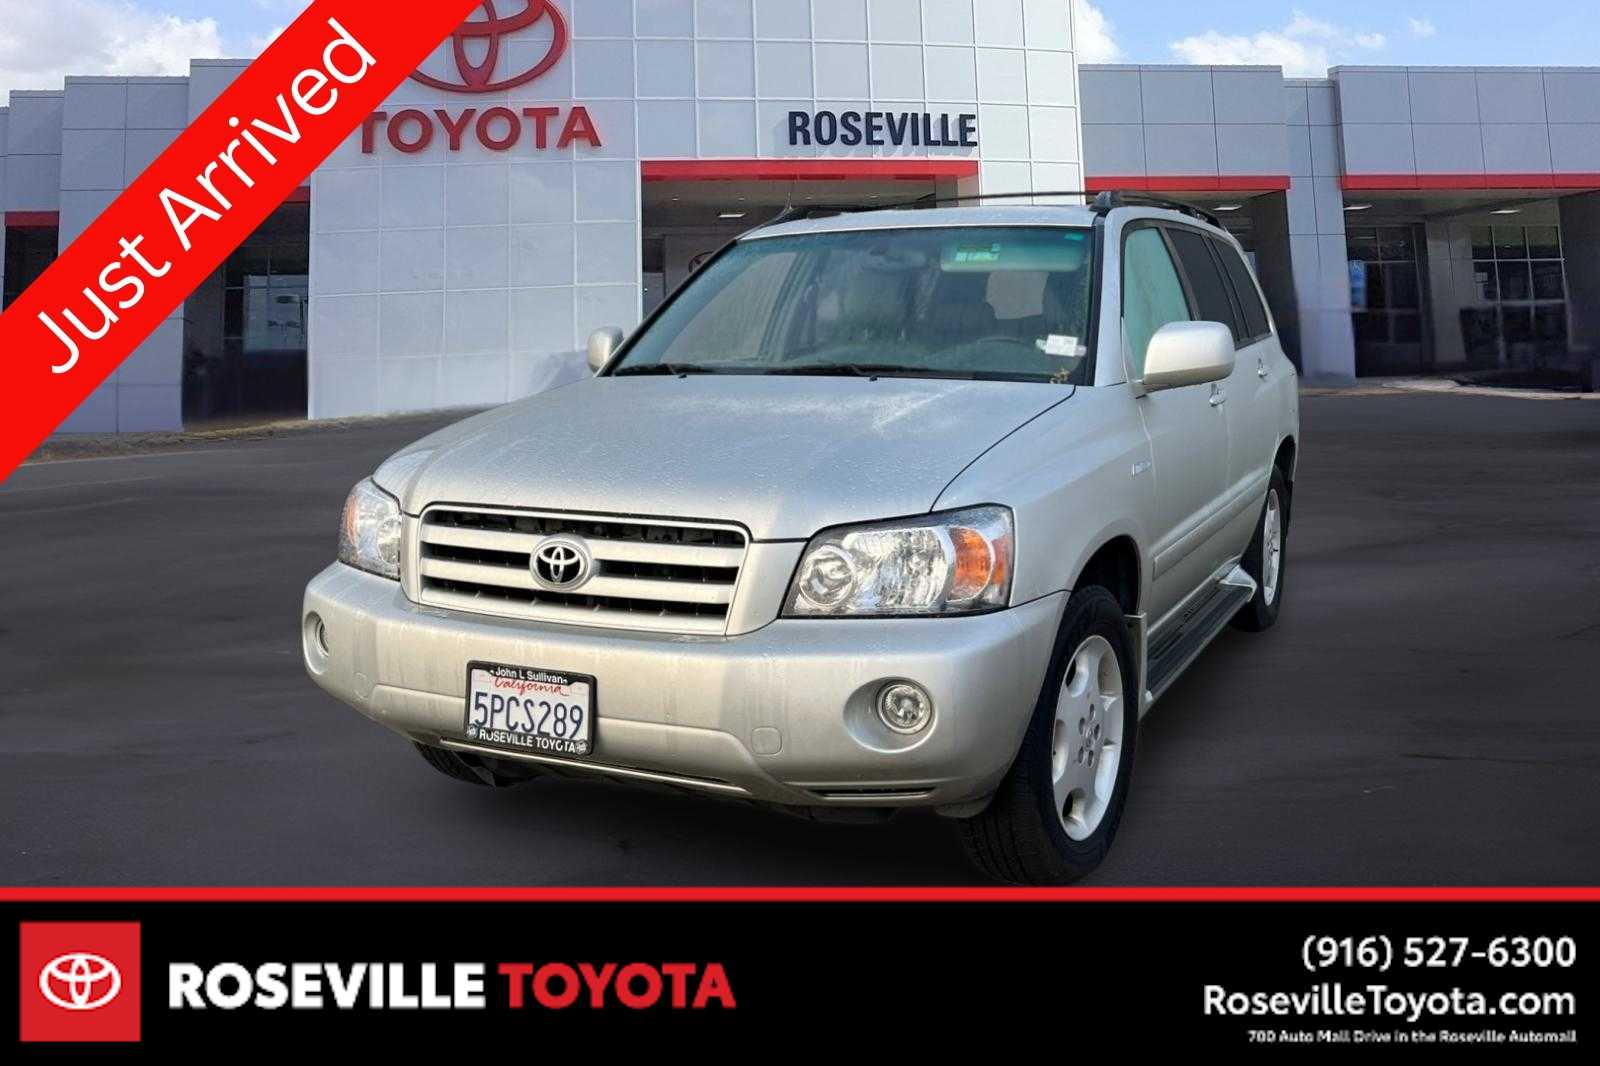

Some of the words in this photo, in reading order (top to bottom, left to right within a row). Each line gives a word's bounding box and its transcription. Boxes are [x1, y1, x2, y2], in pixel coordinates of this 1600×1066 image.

[360, 106, 602, 154] TOYOTA
[788, 111, 978, 147] ROSEVILLE
[494, 677, 569, 696] California
[495, 666, 518, 680] John
[519, 670, 525, 680] L
[527, 670, 564, 684] Sullivan
[474, 691, 584, 740] 5PCS289
[478, 729, 534, 748] ROSEVILLE
[536, 737, 576, 754] TOYOTA
